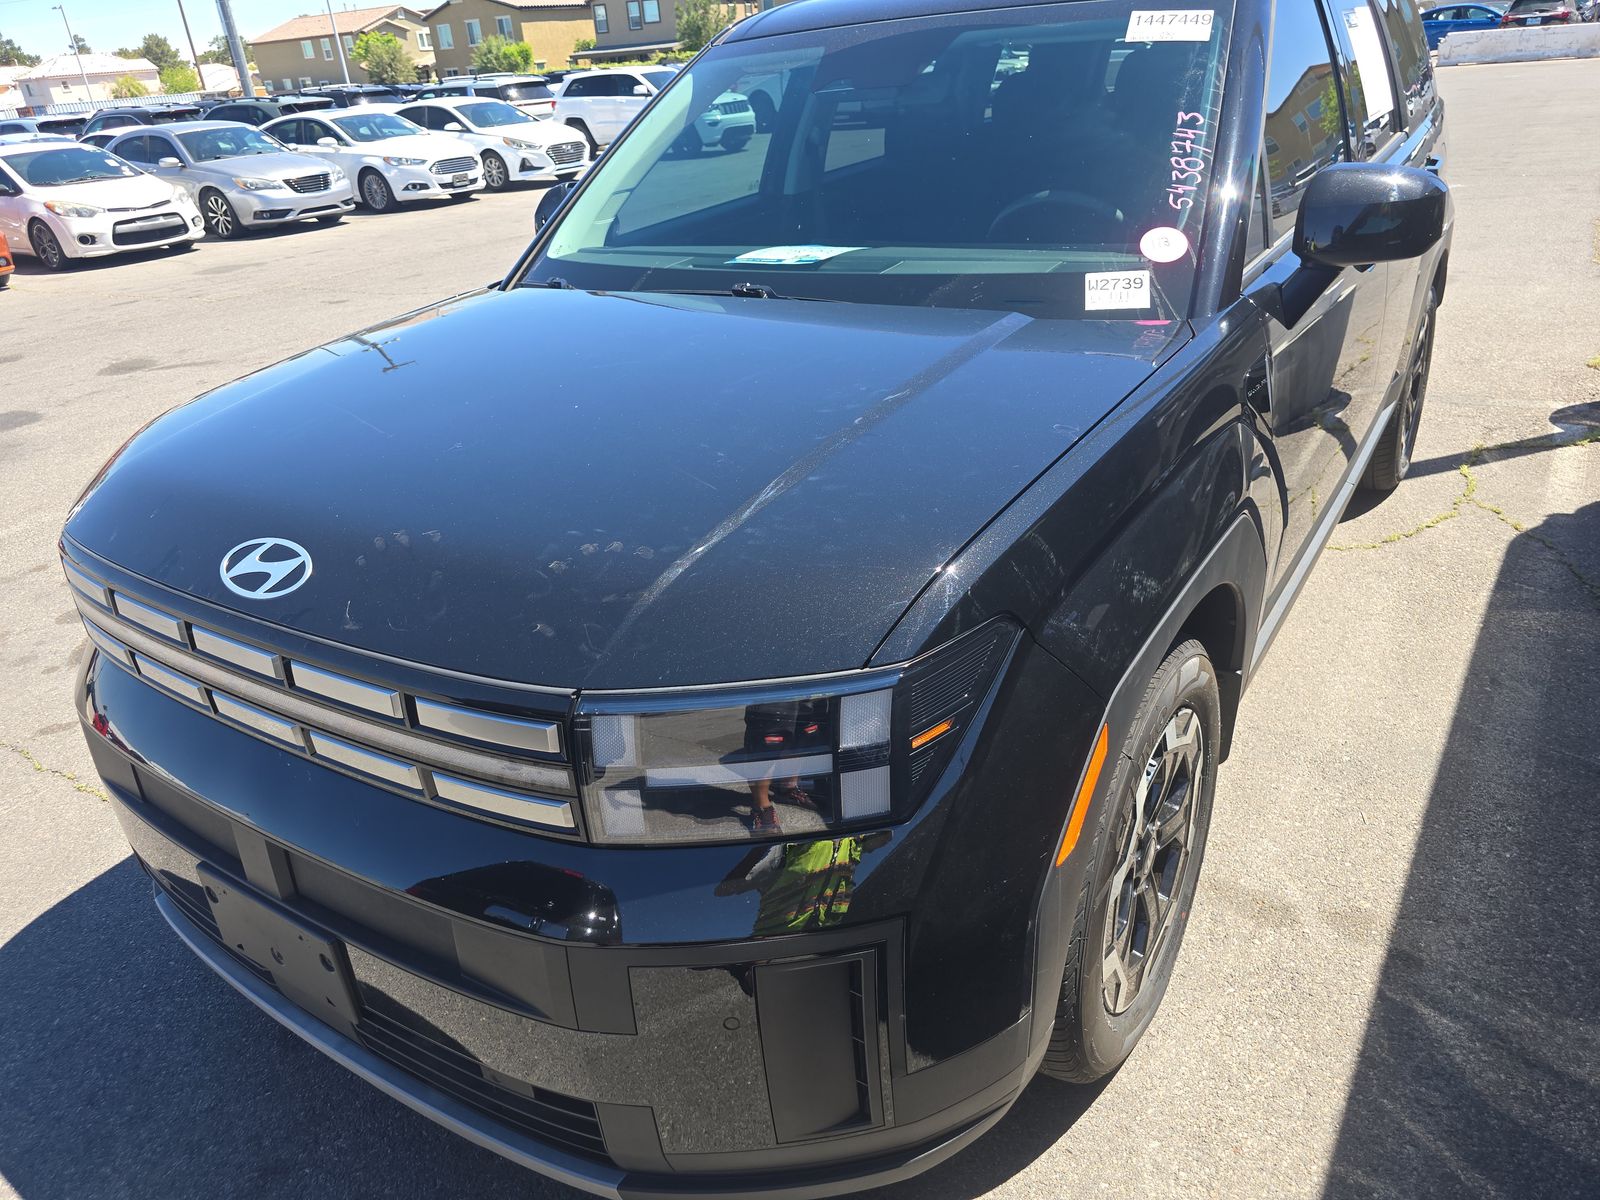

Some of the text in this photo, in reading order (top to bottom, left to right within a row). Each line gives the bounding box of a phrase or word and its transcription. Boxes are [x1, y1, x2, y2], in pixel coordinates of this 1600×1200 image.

[1135, 13, 1213, 26] 1447449
[1166, 111, 1211, 210] 5438743
[1088, 277, 1144, 291] W2739
